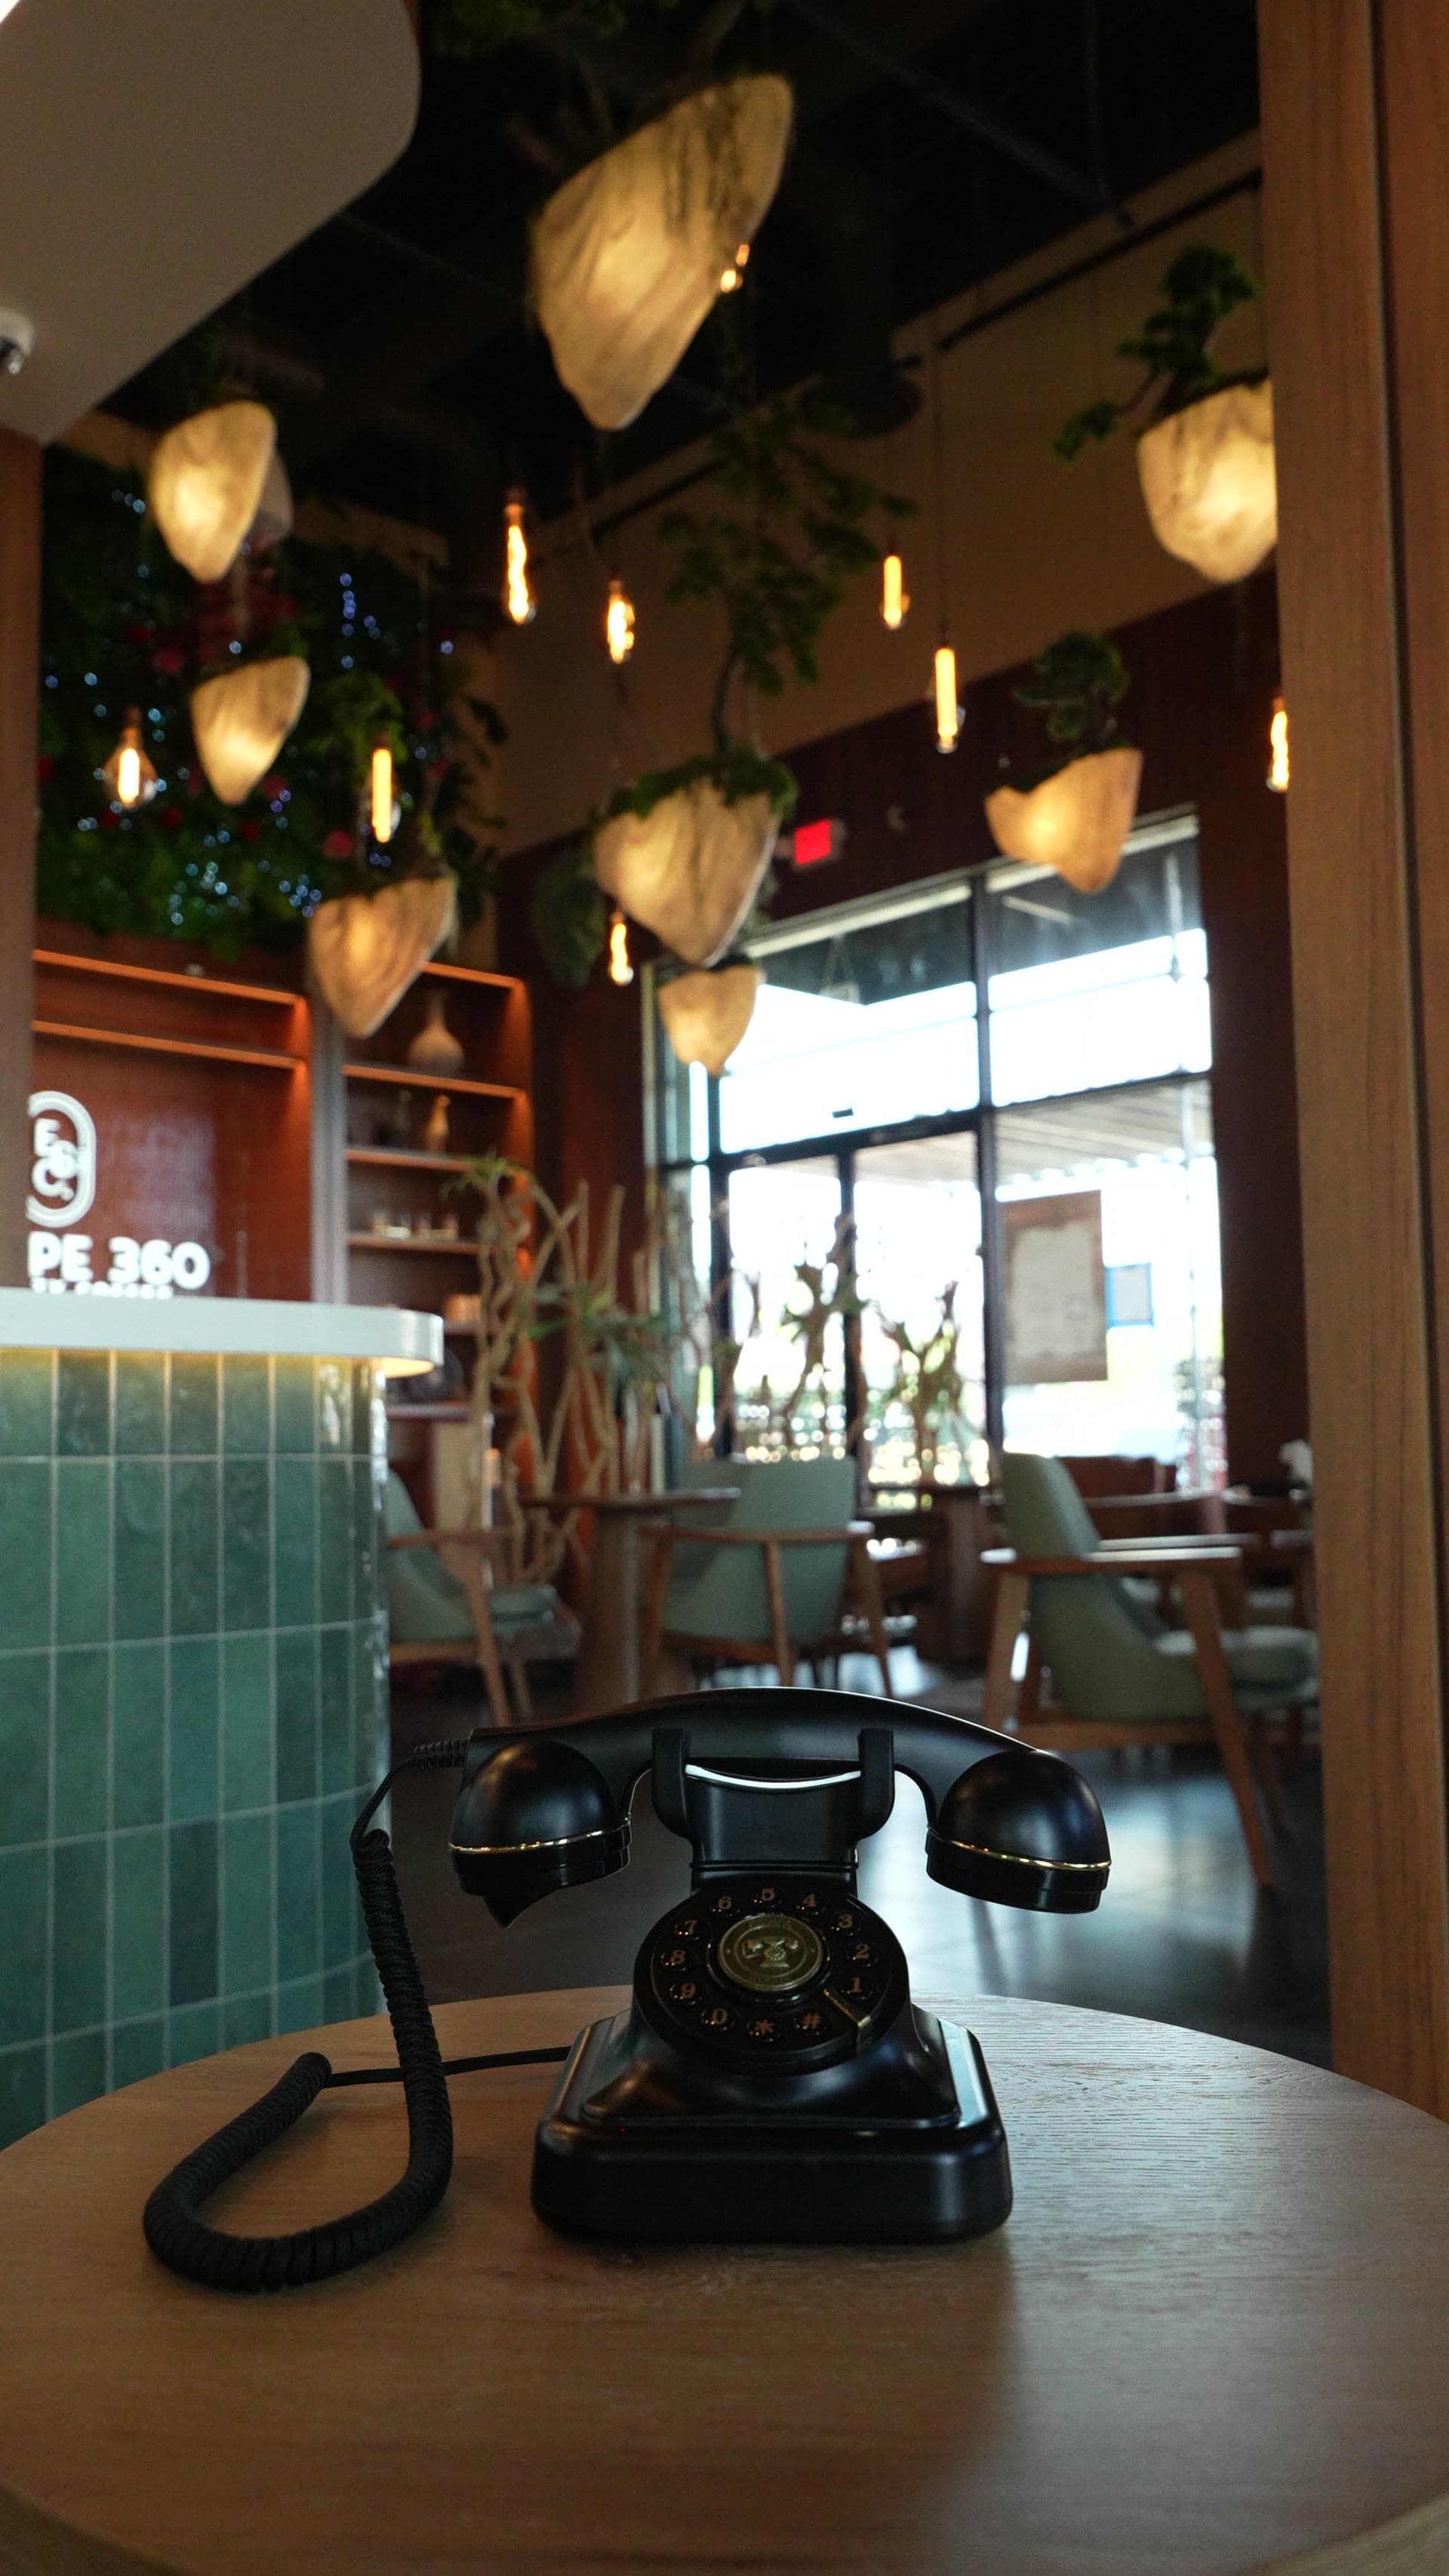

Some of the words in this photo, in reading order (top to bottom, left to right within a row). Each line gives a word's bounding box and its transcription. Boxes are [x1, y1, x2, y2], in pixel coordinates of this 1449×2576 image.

[108, 1237, 211, 1290] 360
[761, 1886, 775, 1901] 5
[802, 1892, 816, 1907] 4
[718, 1895, 732, 1909] 6
[685, 1920, 698, 1935] 7
[838, 1914, 853, 1929] 3
[671, 1950, 685, 1964] 8
[855, 1944, 869, 1959] 2
[681, 1982, 696, 1998] 9
[851, 1977, 863, 1993] 1
[712, 2008, 728, 2024] 0
